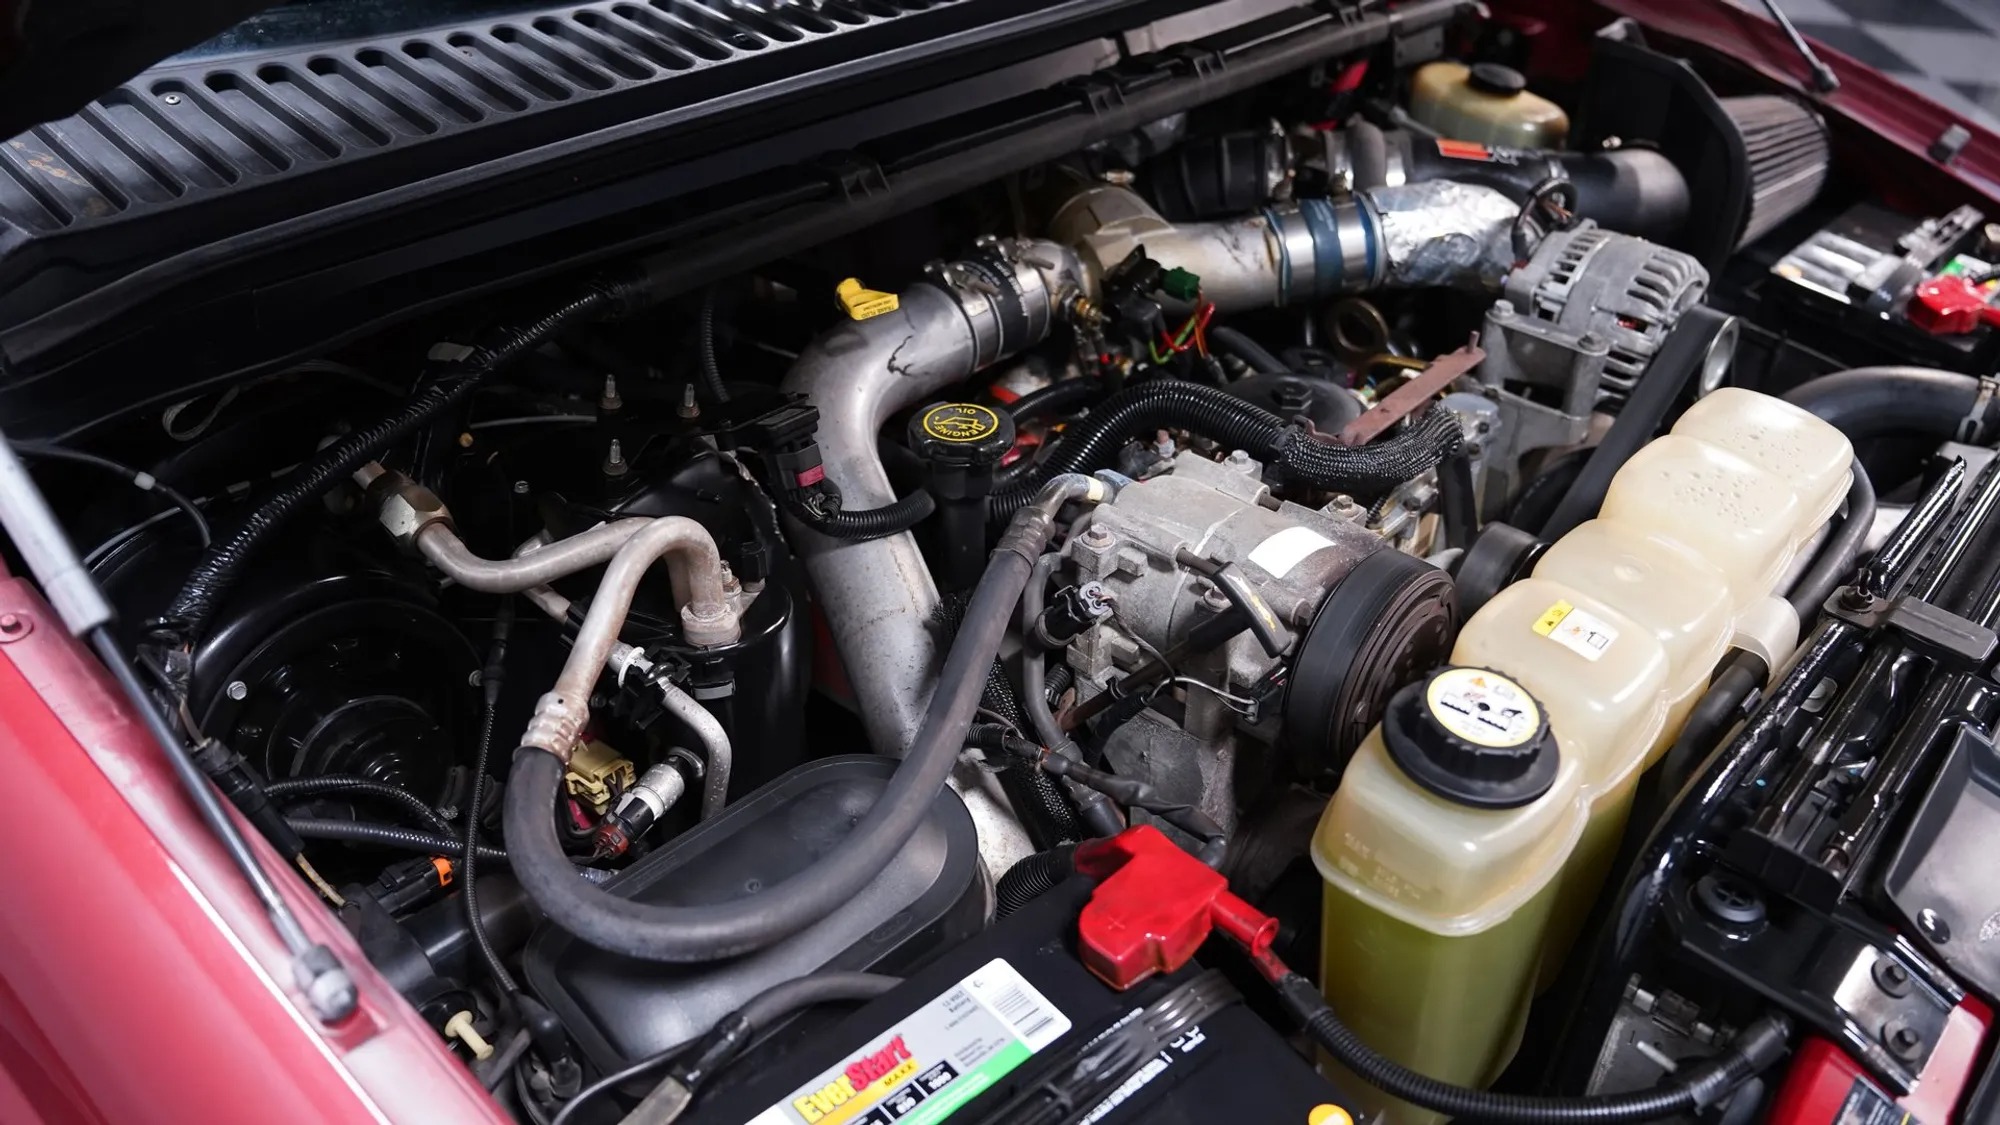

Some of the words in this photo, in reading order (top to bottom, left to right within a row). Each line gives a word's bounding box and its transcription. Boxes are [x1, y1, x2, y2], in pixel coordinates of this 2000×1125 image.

[956, 407, 977, 415] OIL
[934, 424, 980, 437] ENGINE
[884, 1063, 914, 1087] MAXX
